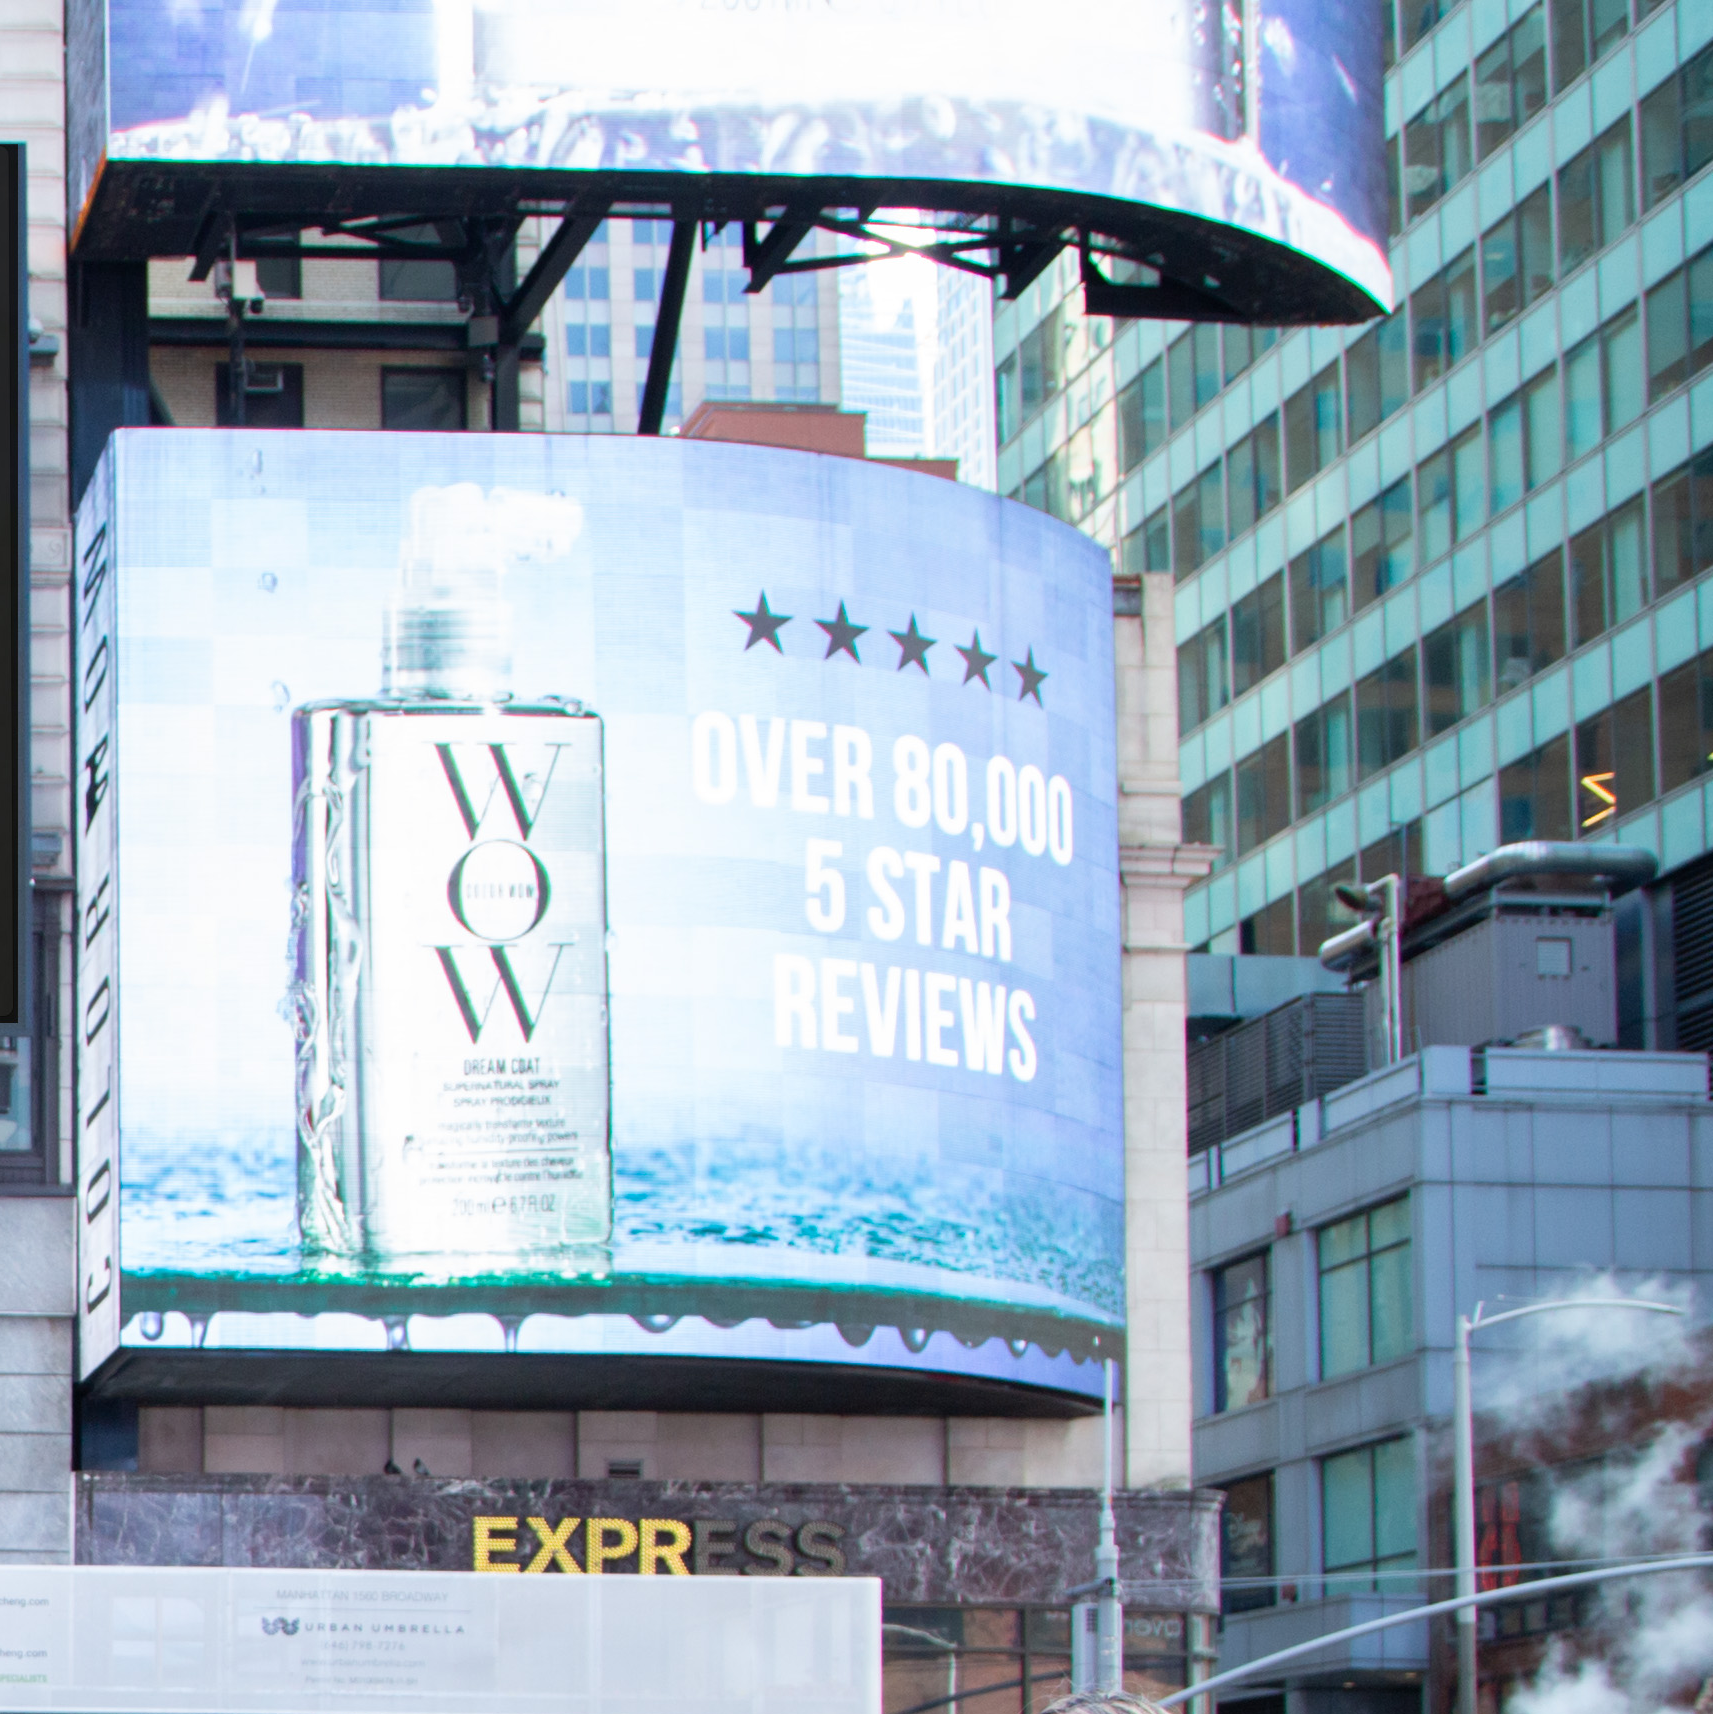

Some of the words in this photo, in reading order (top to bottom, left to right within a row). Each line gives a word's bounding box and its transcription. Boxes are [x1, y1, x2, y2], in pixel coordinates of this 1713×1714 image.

[691, 710, 875, 820] OVER
[893, 734, 1073, 866] 80,000
[804, 837, 846, 933] 5
[866, 846, 1012, 962] STAR
[775, 952, 1037, 1082] REVIEWS
[472, 1515, 847, 1577] EXPRESS
[276, 1589, 350, 1602] MANHATTAN
[382, 1590, 449, 1603] BROADWAY
[305, 1622, 364, 1632] URBAN
[371, 1623, 465, 1634] UMBRELLA
